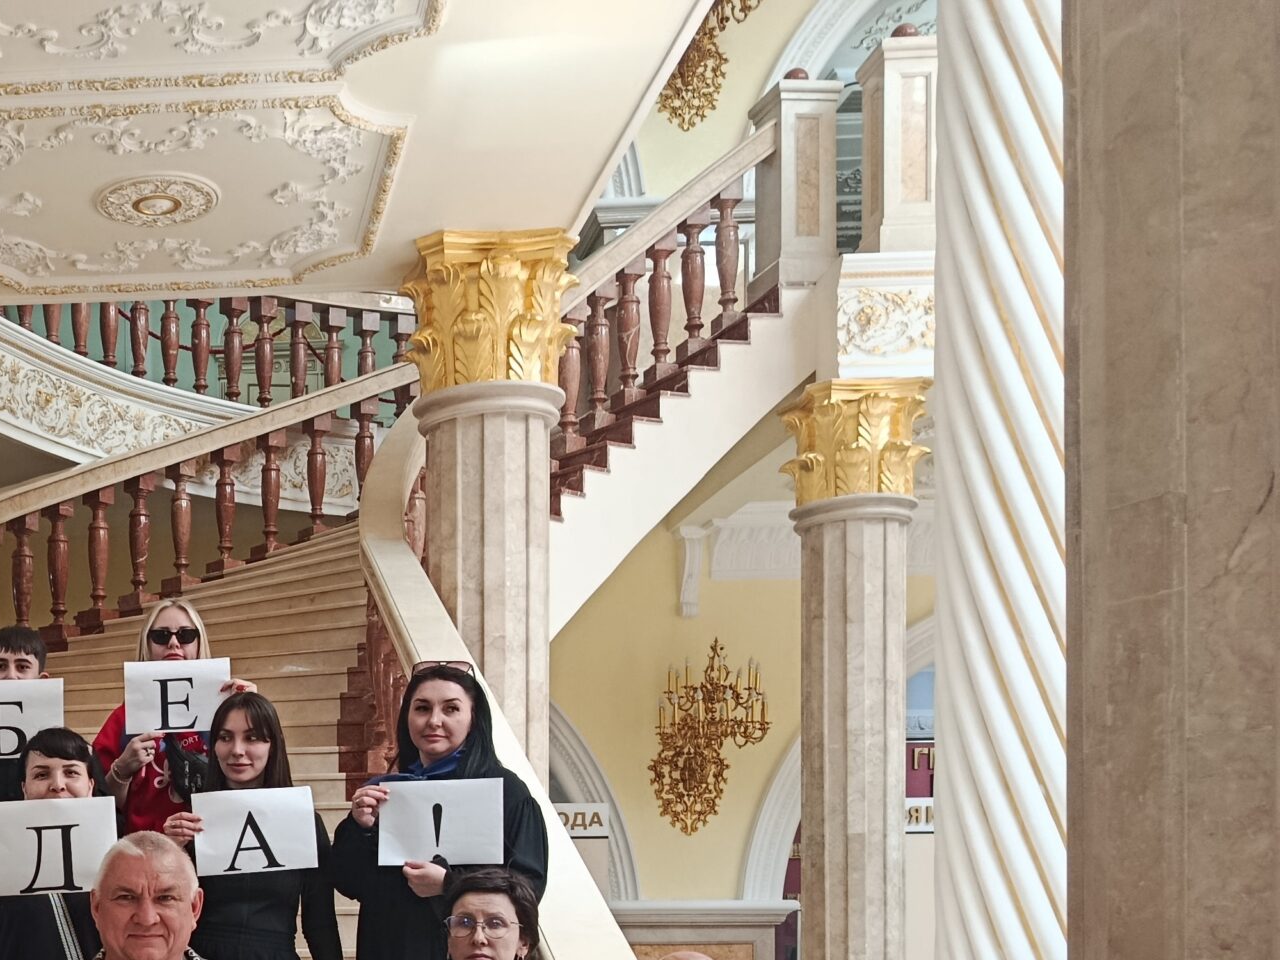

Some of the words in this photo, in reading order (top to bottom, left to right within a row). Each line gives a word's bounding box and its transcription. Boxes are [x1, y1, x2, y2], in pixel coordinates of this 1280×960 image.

[153, 677, 197, 731] Е
[19, 823, 84, 895] Д
[223, 810, 286, 873] А
